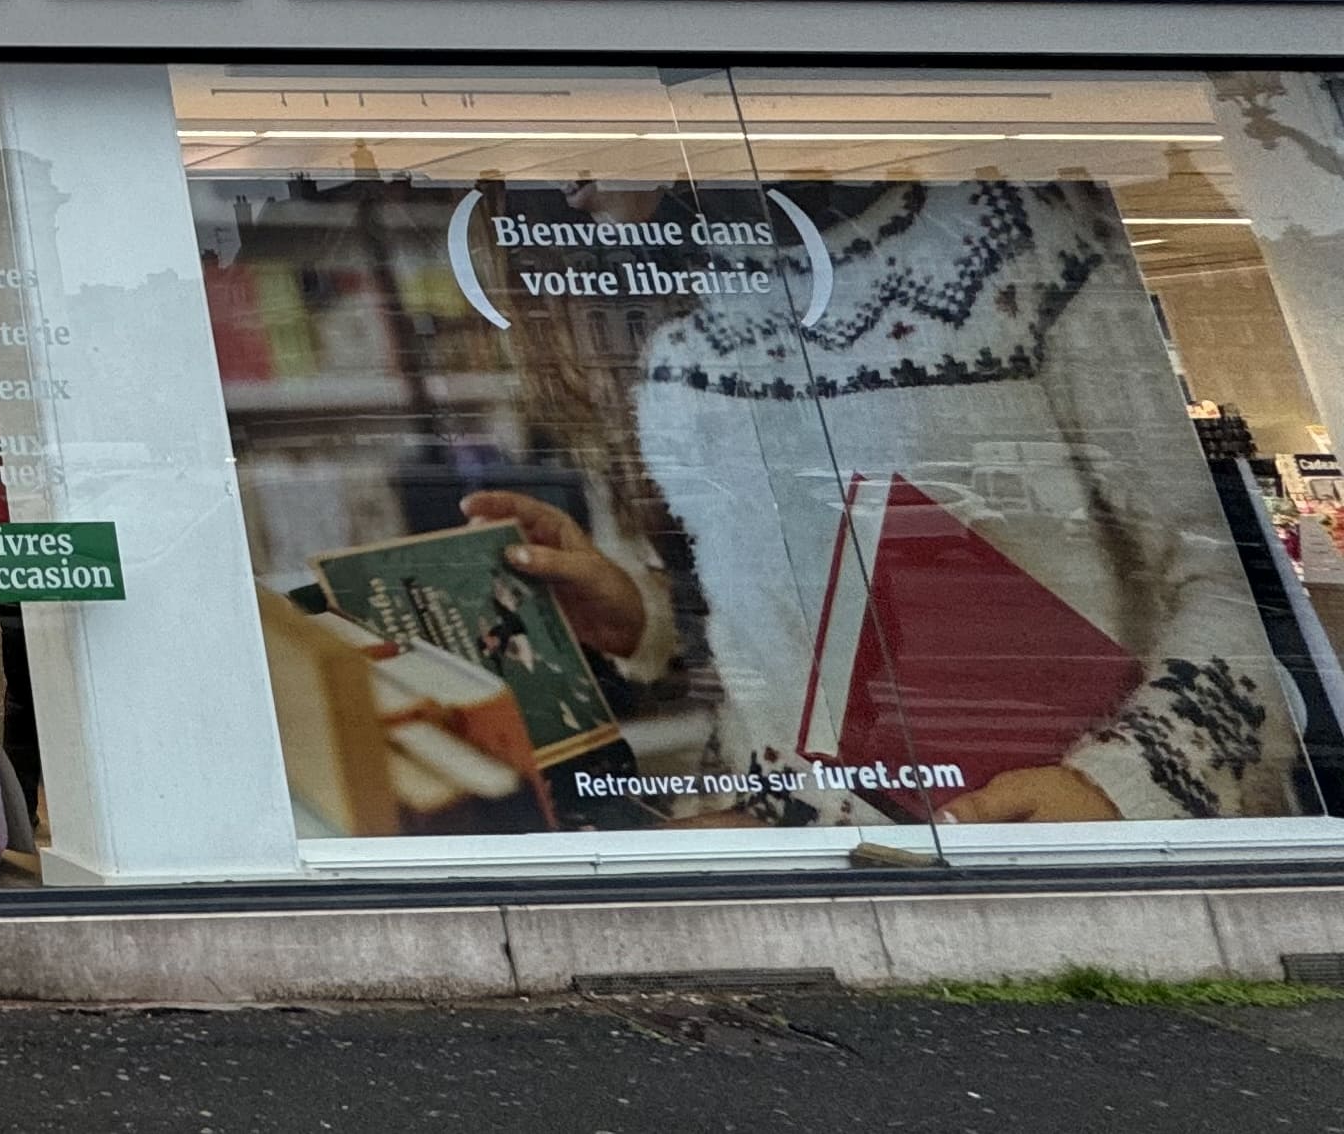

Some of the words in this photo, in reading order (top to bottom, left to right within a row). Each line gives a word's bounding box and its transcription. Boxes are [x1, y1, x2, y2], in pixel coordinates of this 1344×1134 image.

[491, 214, 683, 247] Bienvenue
[690, 213, 775, 245] dans
[520, 269, 619, 296] votre
[627, 262, 771, 296] librairie
[575, 771, 698, 797] Retrouvez
[703, 772, 763, 794] nous
[768, 770, 807, 792] sur
[811, 760, 965, 790] furet.com
